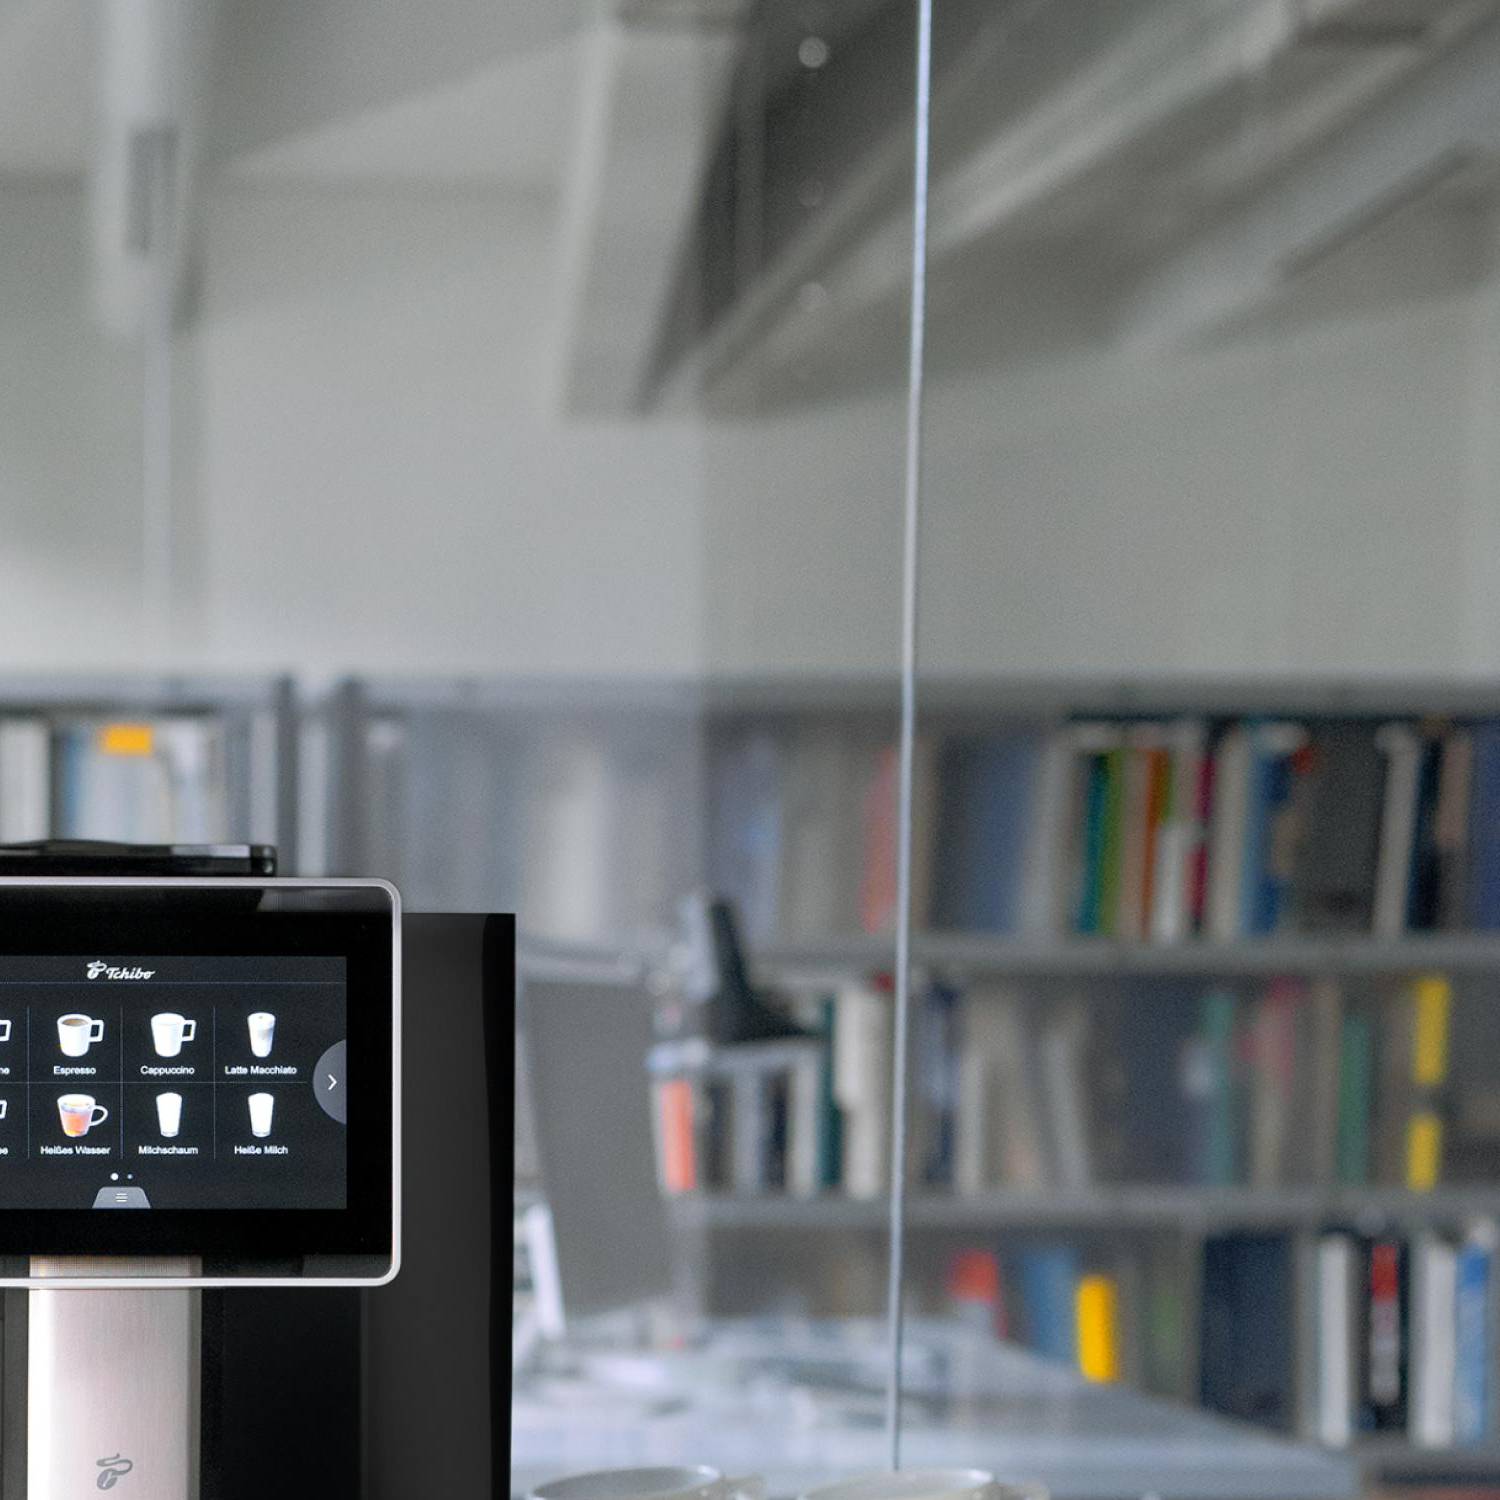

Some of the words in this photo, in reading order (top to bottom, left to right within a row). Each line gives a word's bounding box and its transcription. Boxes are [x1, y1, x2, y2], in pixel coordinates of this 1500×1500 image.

[106, 966, 155, 980] Tchibo
[53, 1066, 97, 1077] Espresso
[140, 1066, 195, 1077] Cappuccino
[225, 1066, 248, 1075] Latte
[250, 1066, 297, 1075] Macchiato
[40, 1145, 74, 1155] Heißes
[75, 1145, 111, 1155] Wasser
[138, 1145, 199, 1155] Milchschaum
[234, 1145, 262, 1155] Heiße
[264, 1145, 288, 1155] Milch
